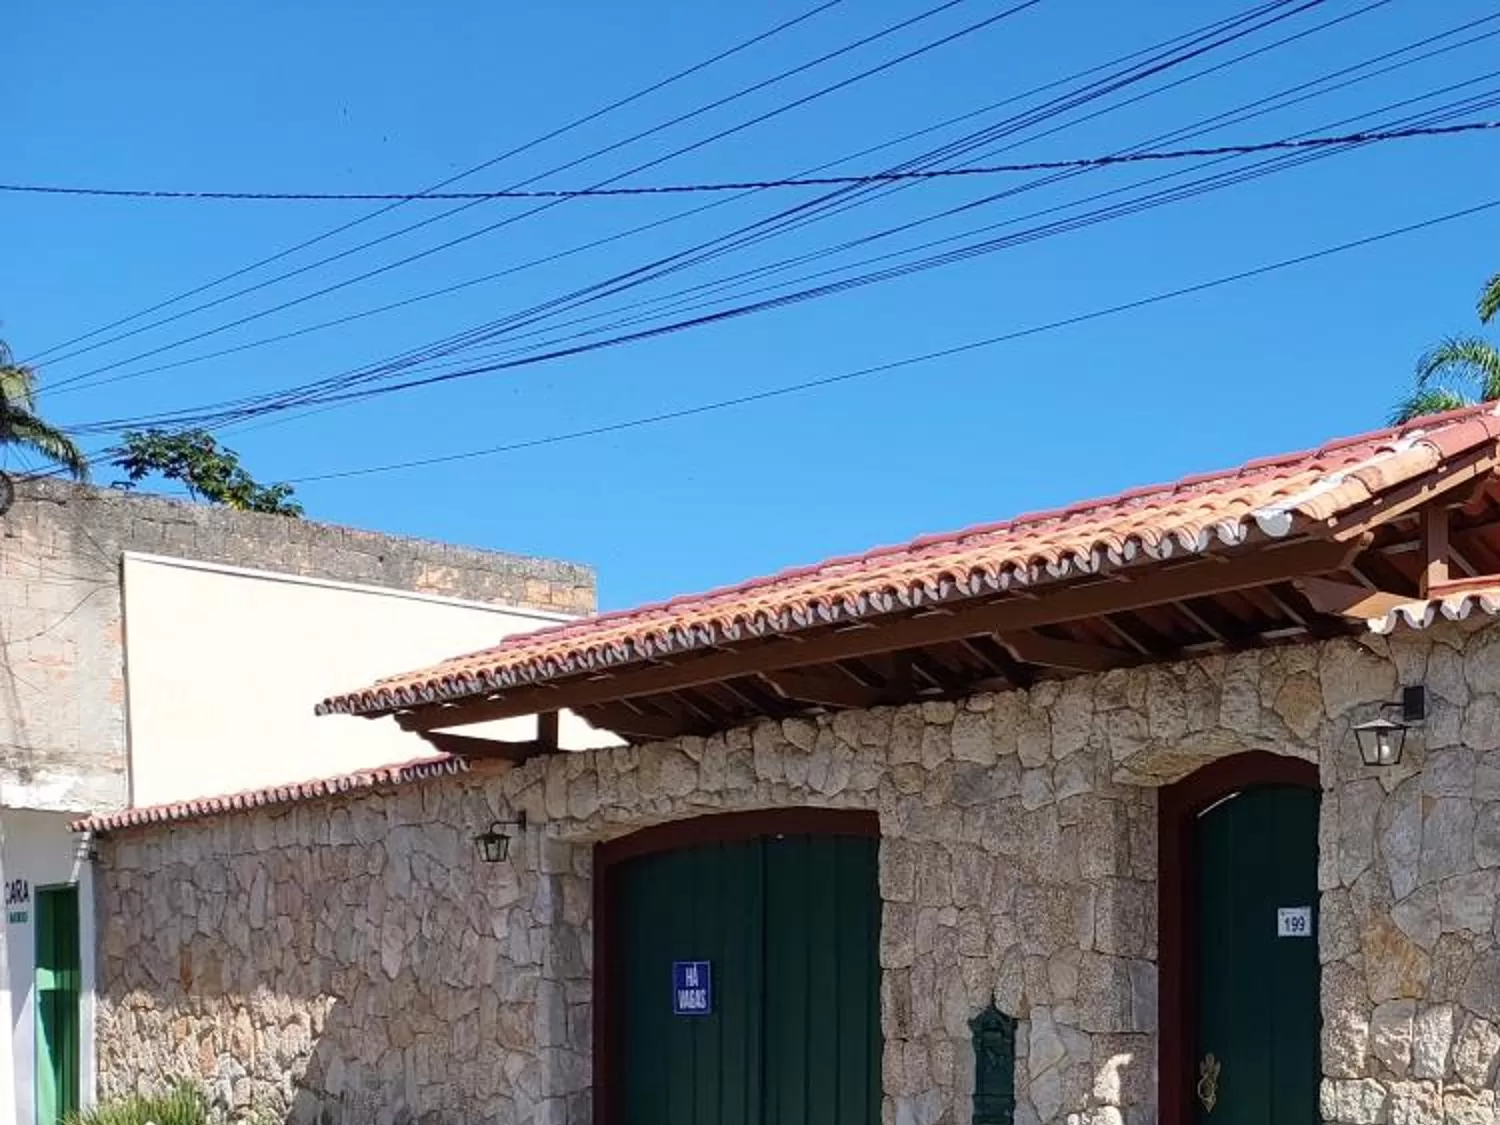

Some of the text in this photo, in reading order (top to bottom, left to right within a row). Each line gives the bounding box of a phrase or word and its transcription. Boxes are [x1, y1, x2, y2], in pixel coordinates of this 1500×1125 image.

[1284, 916, 1305, 932] 199
[685, 963, 699, 987] HÁ
[678, 989, 707, 1009] VAGAS
